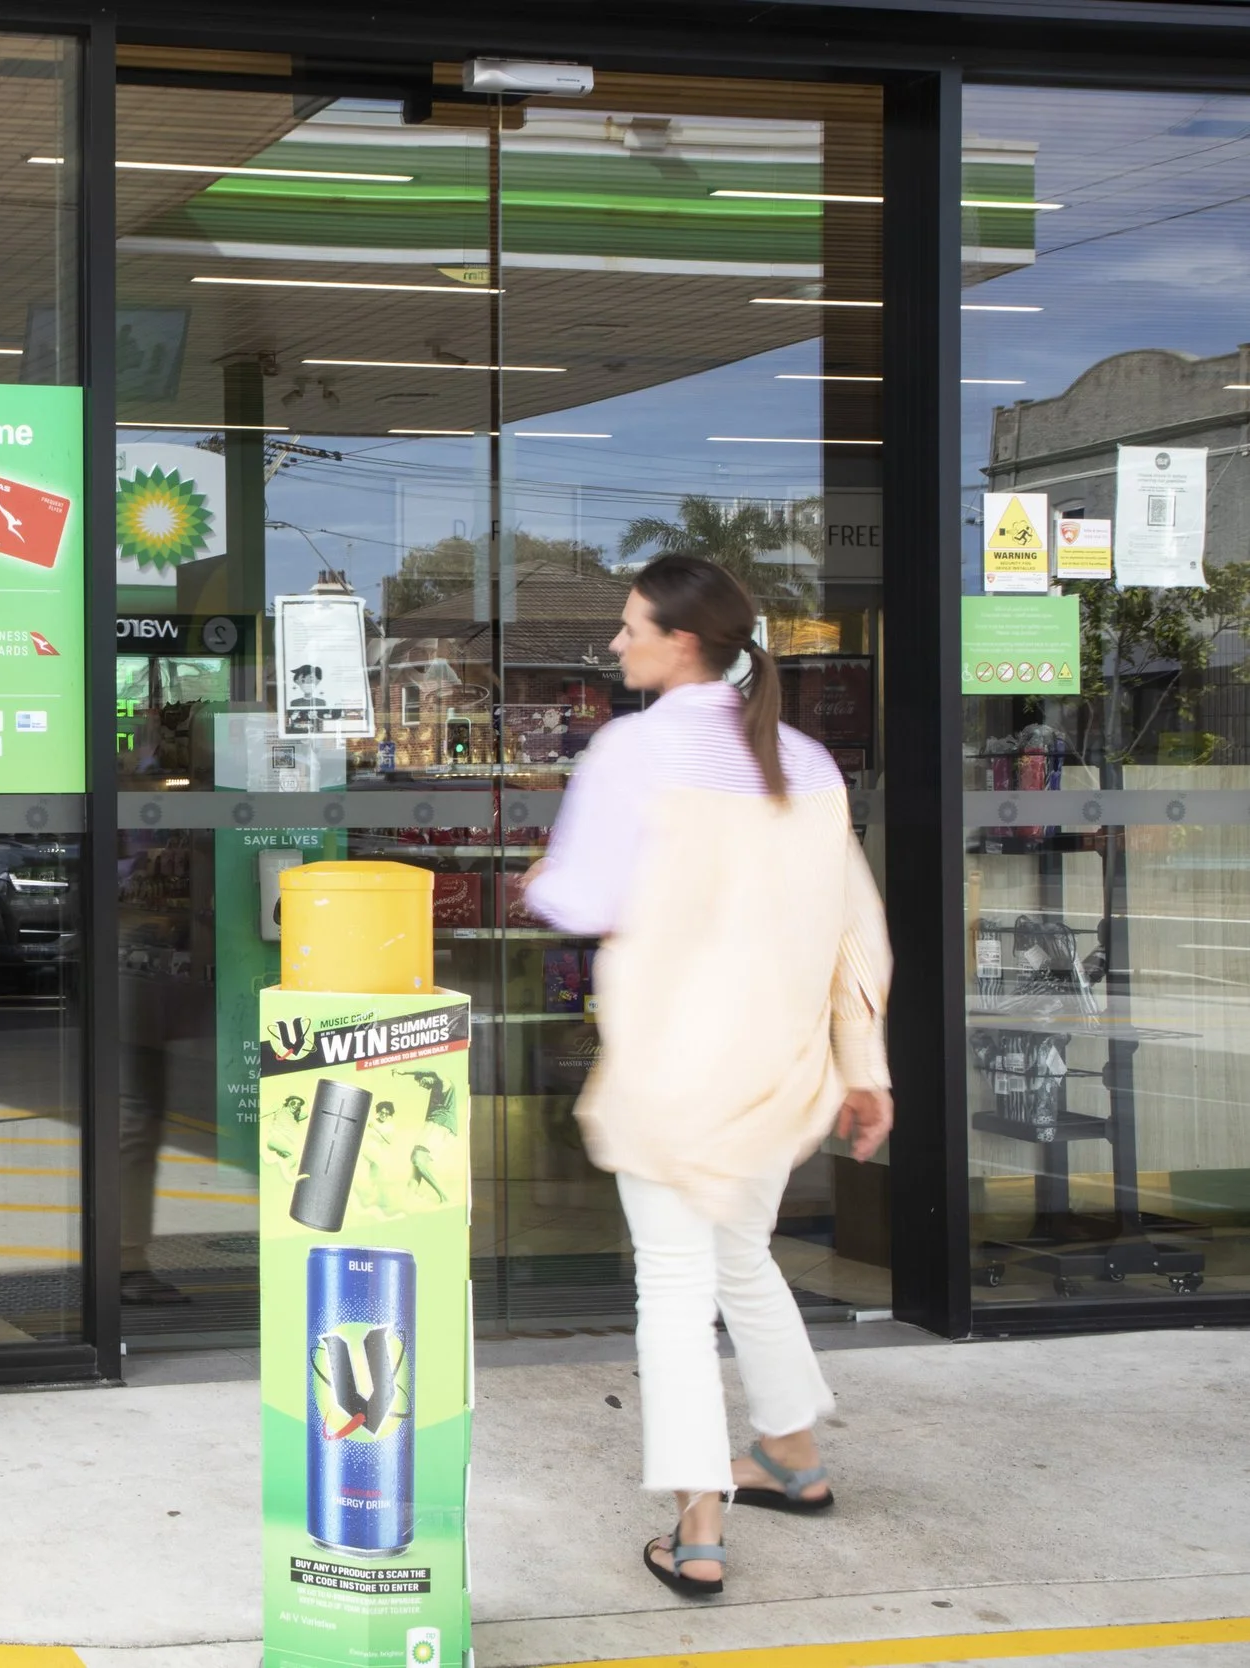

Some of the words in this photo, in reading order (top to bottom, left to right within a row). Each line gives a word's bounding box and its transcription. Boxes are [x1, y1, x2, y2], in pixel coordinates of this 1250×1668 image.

[828, 524, 880, 547] FREE
[993, 552, 1037, 560] WARNING
[243, 835, 277, 845] SAVE
[281, 835, 318, 845] LIVES
[320, 1017, 348, 1029] MUSIC
[390, 1014, 448, 1036] SUMMER
[321, 1026, 387, 1064] WIN
[390, 1028, 449, 1051] SOUNDS
[227, 1084, 260, 1094] WHE
[236, 1113, 260, 1123] THI
[348, 1260, 374, 1274] BLUE
[295, 1559, 312, 1570] BUY
[313, 1562, 330, 1573] ANY
[338, 1566, 376, 1579] PRODUCT
[377, 1570, 385, 1579] &
[385, 1570, 409, 1579] SCAN
[410, 1569, 426, 1578] THE
[302, 1573, 314, 1584] QR
[315, 1575, 338, 1587] CODE
[339, 1579, 377, 1592] INSTORE
[380, 1584, 390, 1592] TO
[391, 1583, 419, 1592] ENTER
